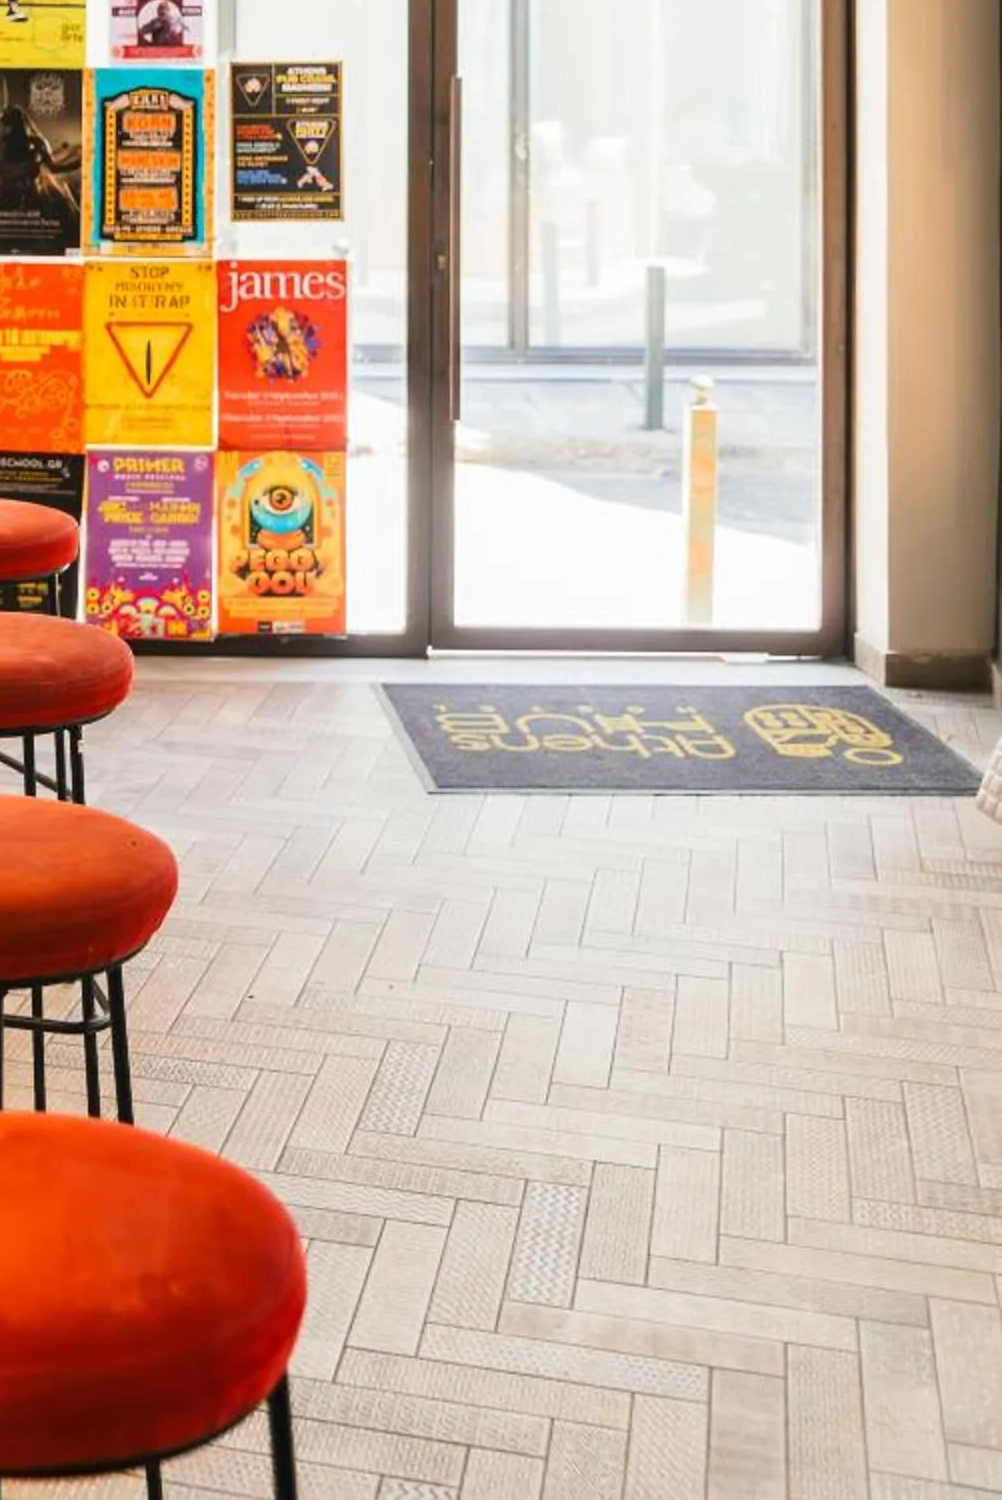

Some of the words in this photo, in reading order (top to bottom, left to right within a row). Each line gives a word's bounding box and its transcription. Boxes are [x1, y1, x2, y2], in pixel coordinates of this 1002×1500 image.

[130, 266, 169, 278] STOP
[220, 260, 345, 313] james
[114, 457, 185, 473] PRIMER
